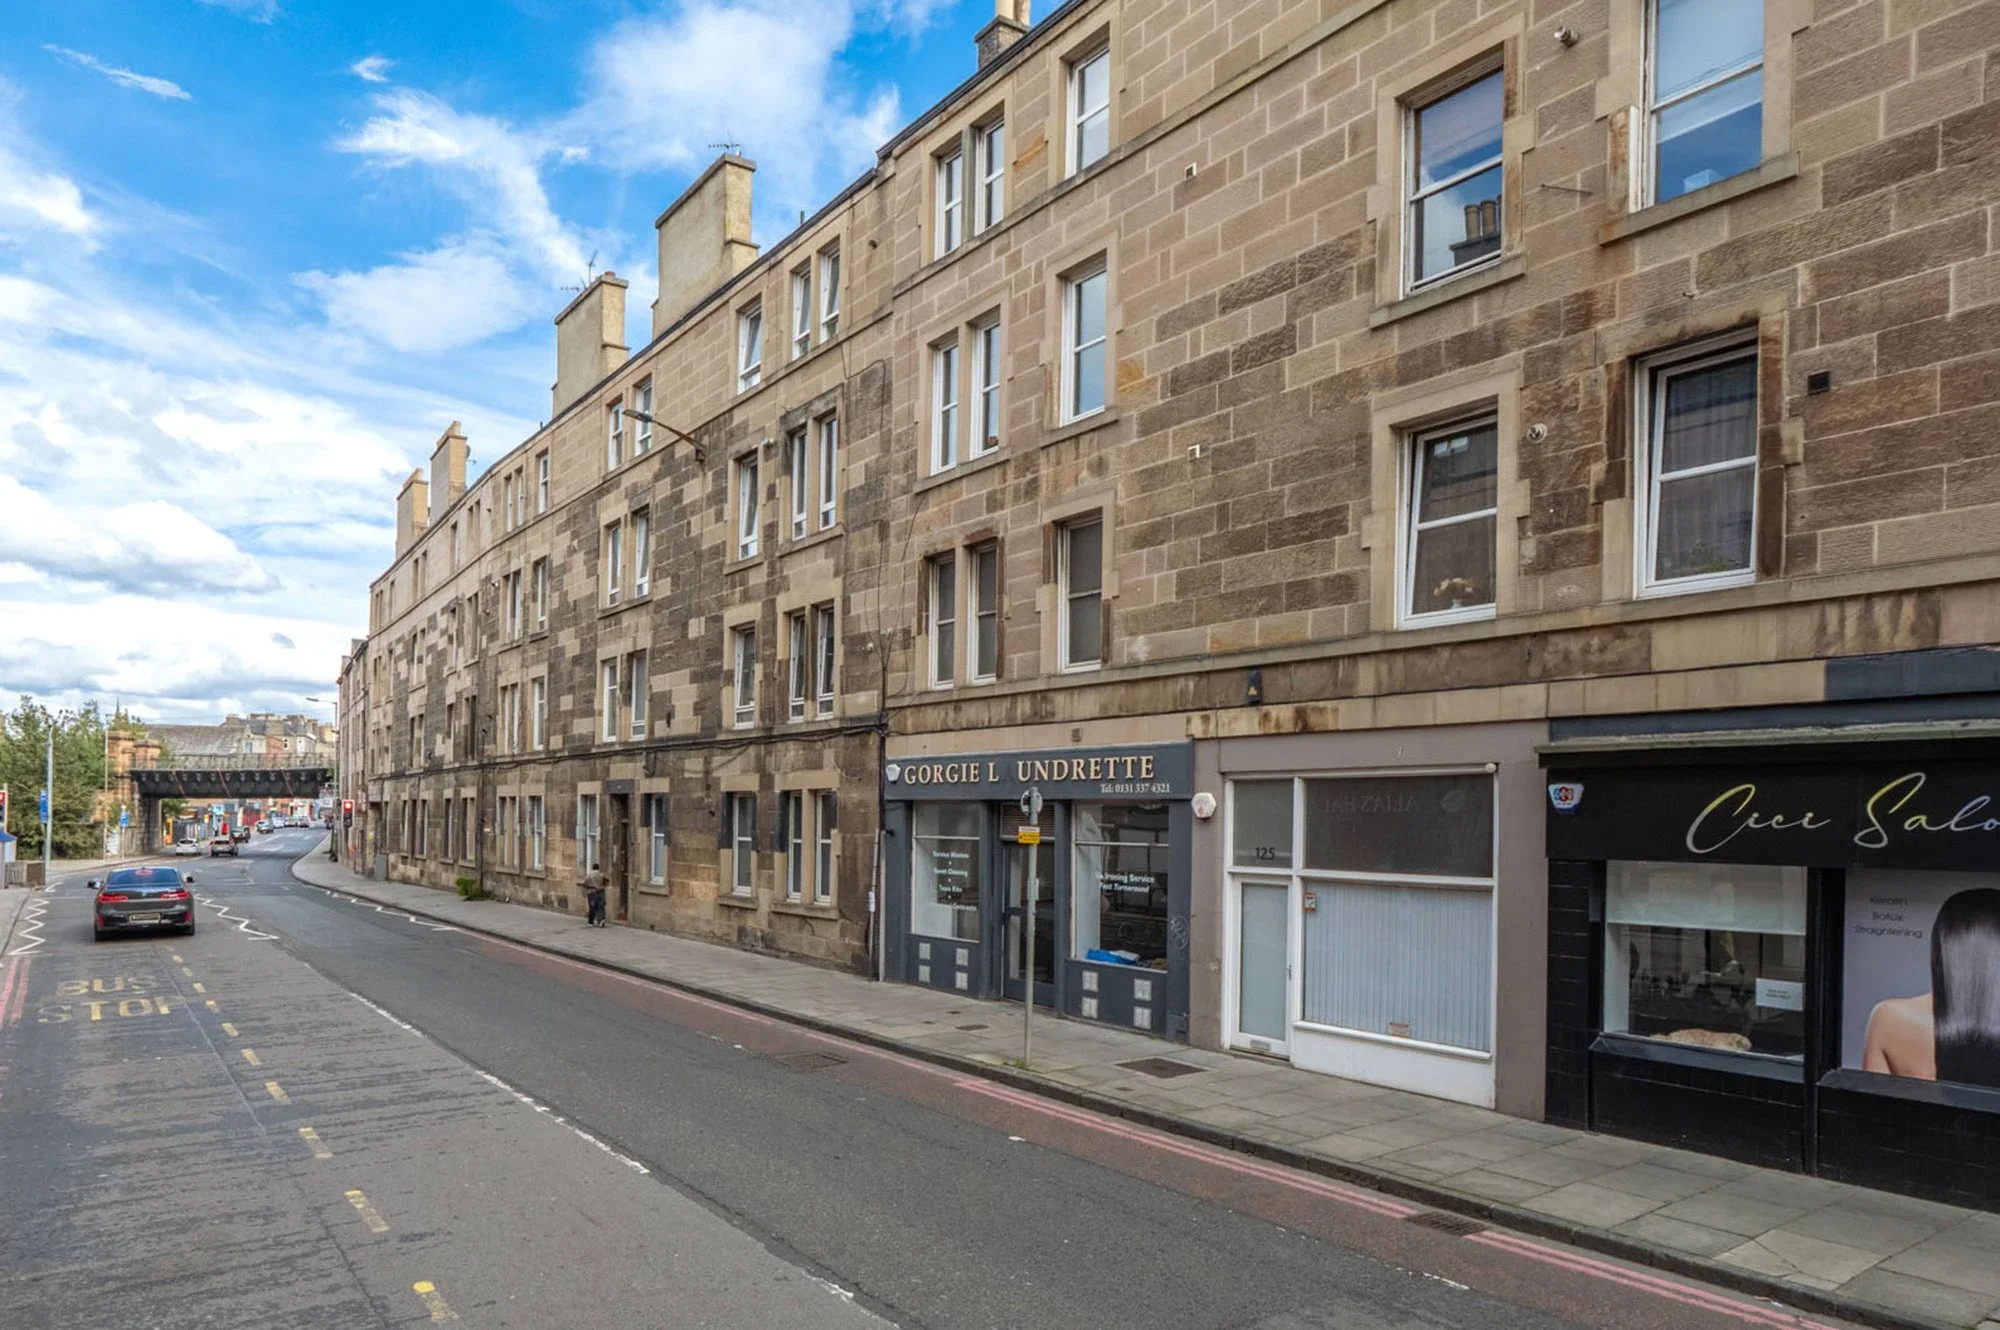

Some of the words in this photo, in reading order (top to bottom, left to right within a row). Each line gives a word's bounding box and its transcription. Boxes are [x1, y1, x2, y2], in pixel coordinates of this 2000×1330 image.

[904, 762, 980, 785] GORGIE
[1101, 783, 1114, 793] Tel:
[1115, 784, 1133, 793] 0131
[1134, 783, 1150, 793] 337
[1151, 783, 1170, 793] 4321
[1686, 784, 1831, 854] Cici
[1255, 847, 1275, 860] 125
[56, 976, 159, 997] BUS
